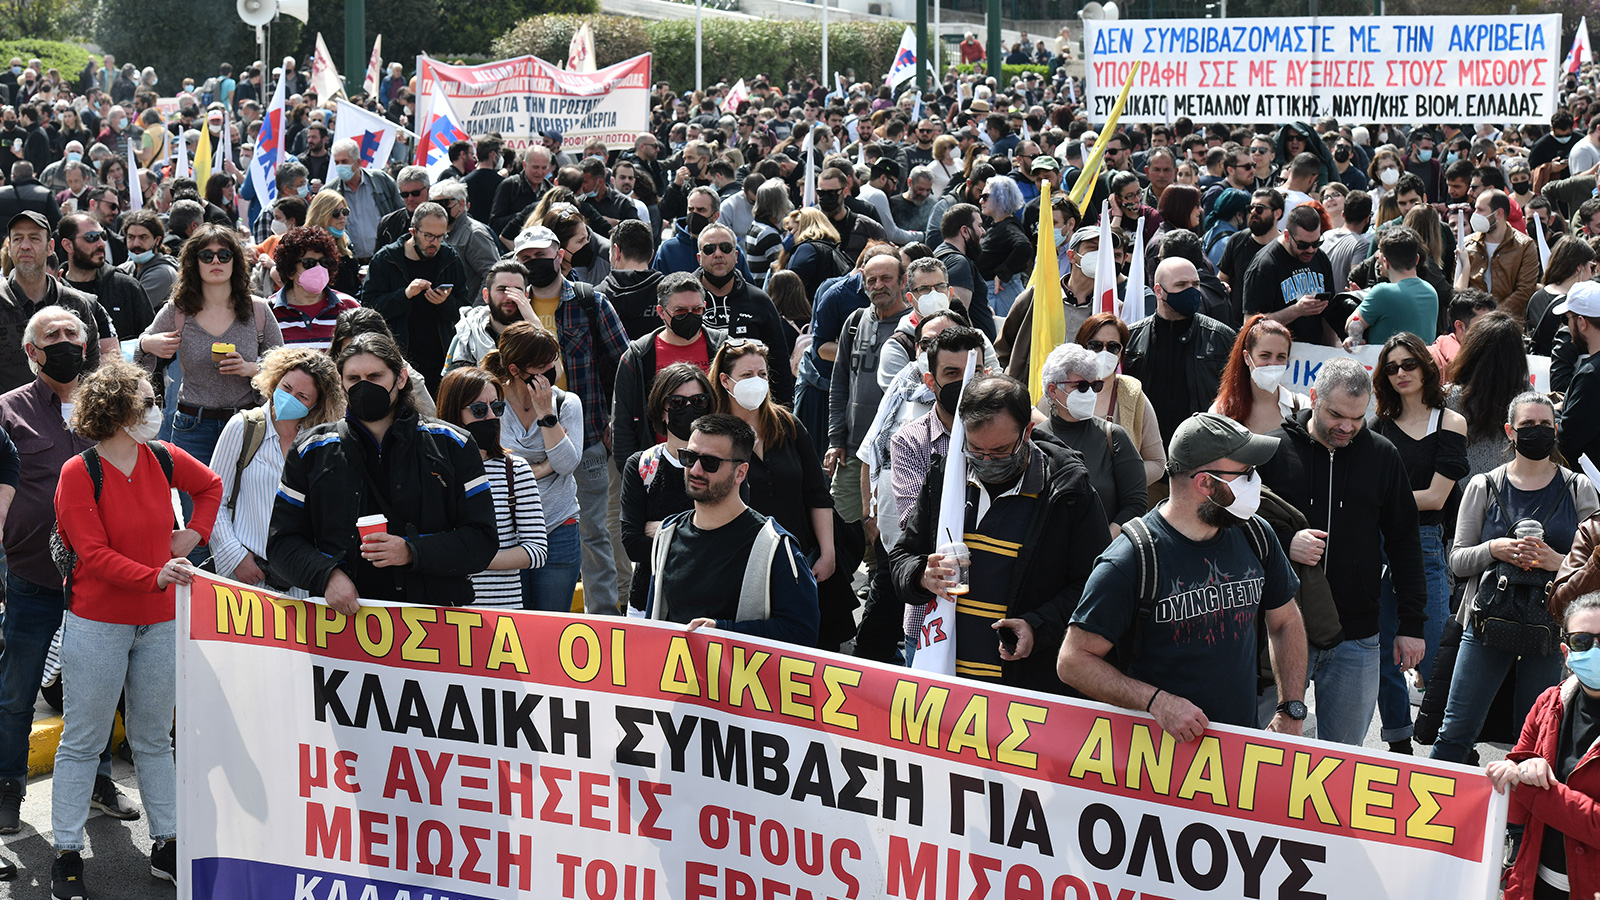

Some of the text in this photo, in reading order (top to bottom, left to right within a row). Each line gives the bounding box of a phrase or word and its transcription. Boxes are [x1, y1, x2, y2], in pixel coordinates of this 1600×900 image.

[1093, 23, 1546, 55] ΔΕΝ ΣΥΜΒΙΒΑΖΟΜΑΣΤΕ ΜΕ ΤΗΝ ΑΚΡΙΒΕΙΑ
[1198, 60, 1239, 87] ΣΣΕ
[1249, 60, 1278, 87] ΜΕ
[1286, 60, 1375, 87] ΑΥΞΗΣΕΙΣ
[1386, 60, 1448, 86] ΣΤΟΥΣ
[1459, 58, 1548, 86] ΜΙΣΘΟΥΣ
[523, 96, 546, 113] ΤΗΝ
[1174, 94, 1250, 116] ΜΕΤΑΛΛΟΥ
[1256, 94, 1320, 117] ΑΤΤΙΚΗΣ
[1416, 94, 1462, 117] ΒΙΟΜ.
[1466, 93, 1543, 116] ΕΛΛΑΔΑΣ
[1155, 586, 1221, 623] DYING
[212, 583, 1457, 845] ΜΠΡΟΣΤΑ ΟΙ ΔΙΚΕΣ ΜΑΣ ΑΝΑΓΚΕΣ
[312, 665, 1327, 900] ΚΛΑΔΙΚΗ ΣΥΜΒΑΣΗ ΓΙΑ ΟΛΟΥΣ
[298, 742, 361, 799] με
[382, 745, 672, 842] ΑΥΞΗΣΕΙΣ
[699, 804, 862, 900] στους
[305, 801, 533, 892] ΜΕΙΩΣΗ
[556, 852, 656, 900] του
